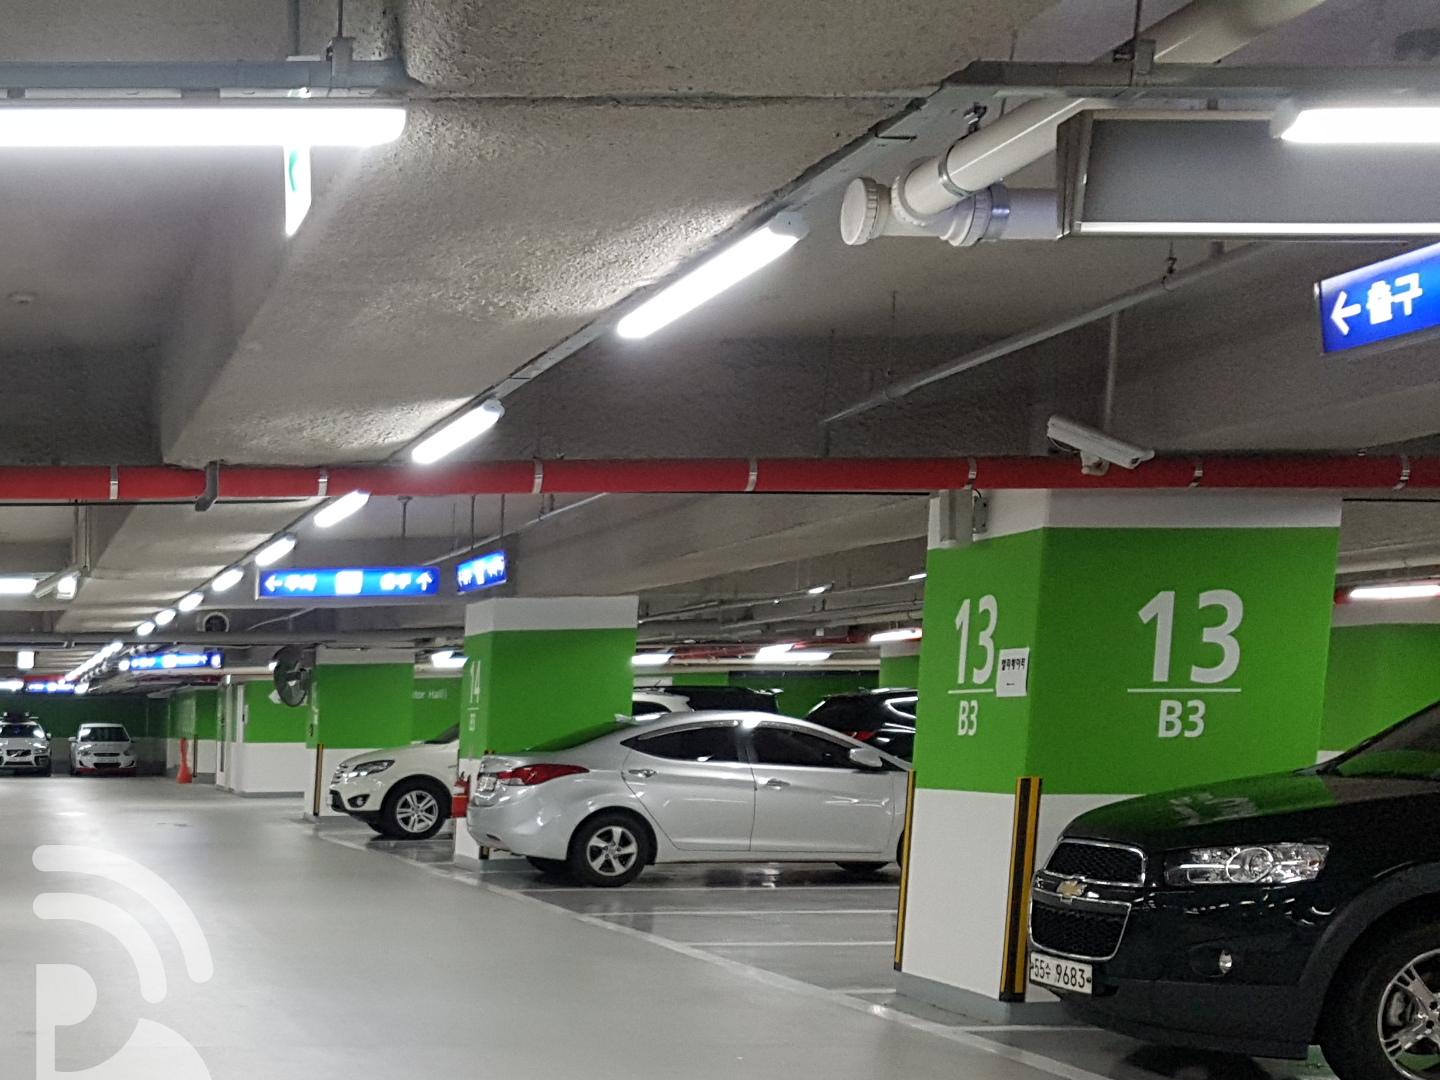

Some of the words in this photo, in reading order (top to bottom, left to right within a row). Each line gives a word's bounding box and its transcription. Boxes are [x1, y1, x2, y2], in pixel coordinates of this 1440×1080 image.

[954, 594, 998, 685] 13
[1138, 590, 1243, 683] 13
[958, 700, 978, 736] B3
[1158, 699, 1205, 738] B3
[1055, 963, 1086, 989] 9683
